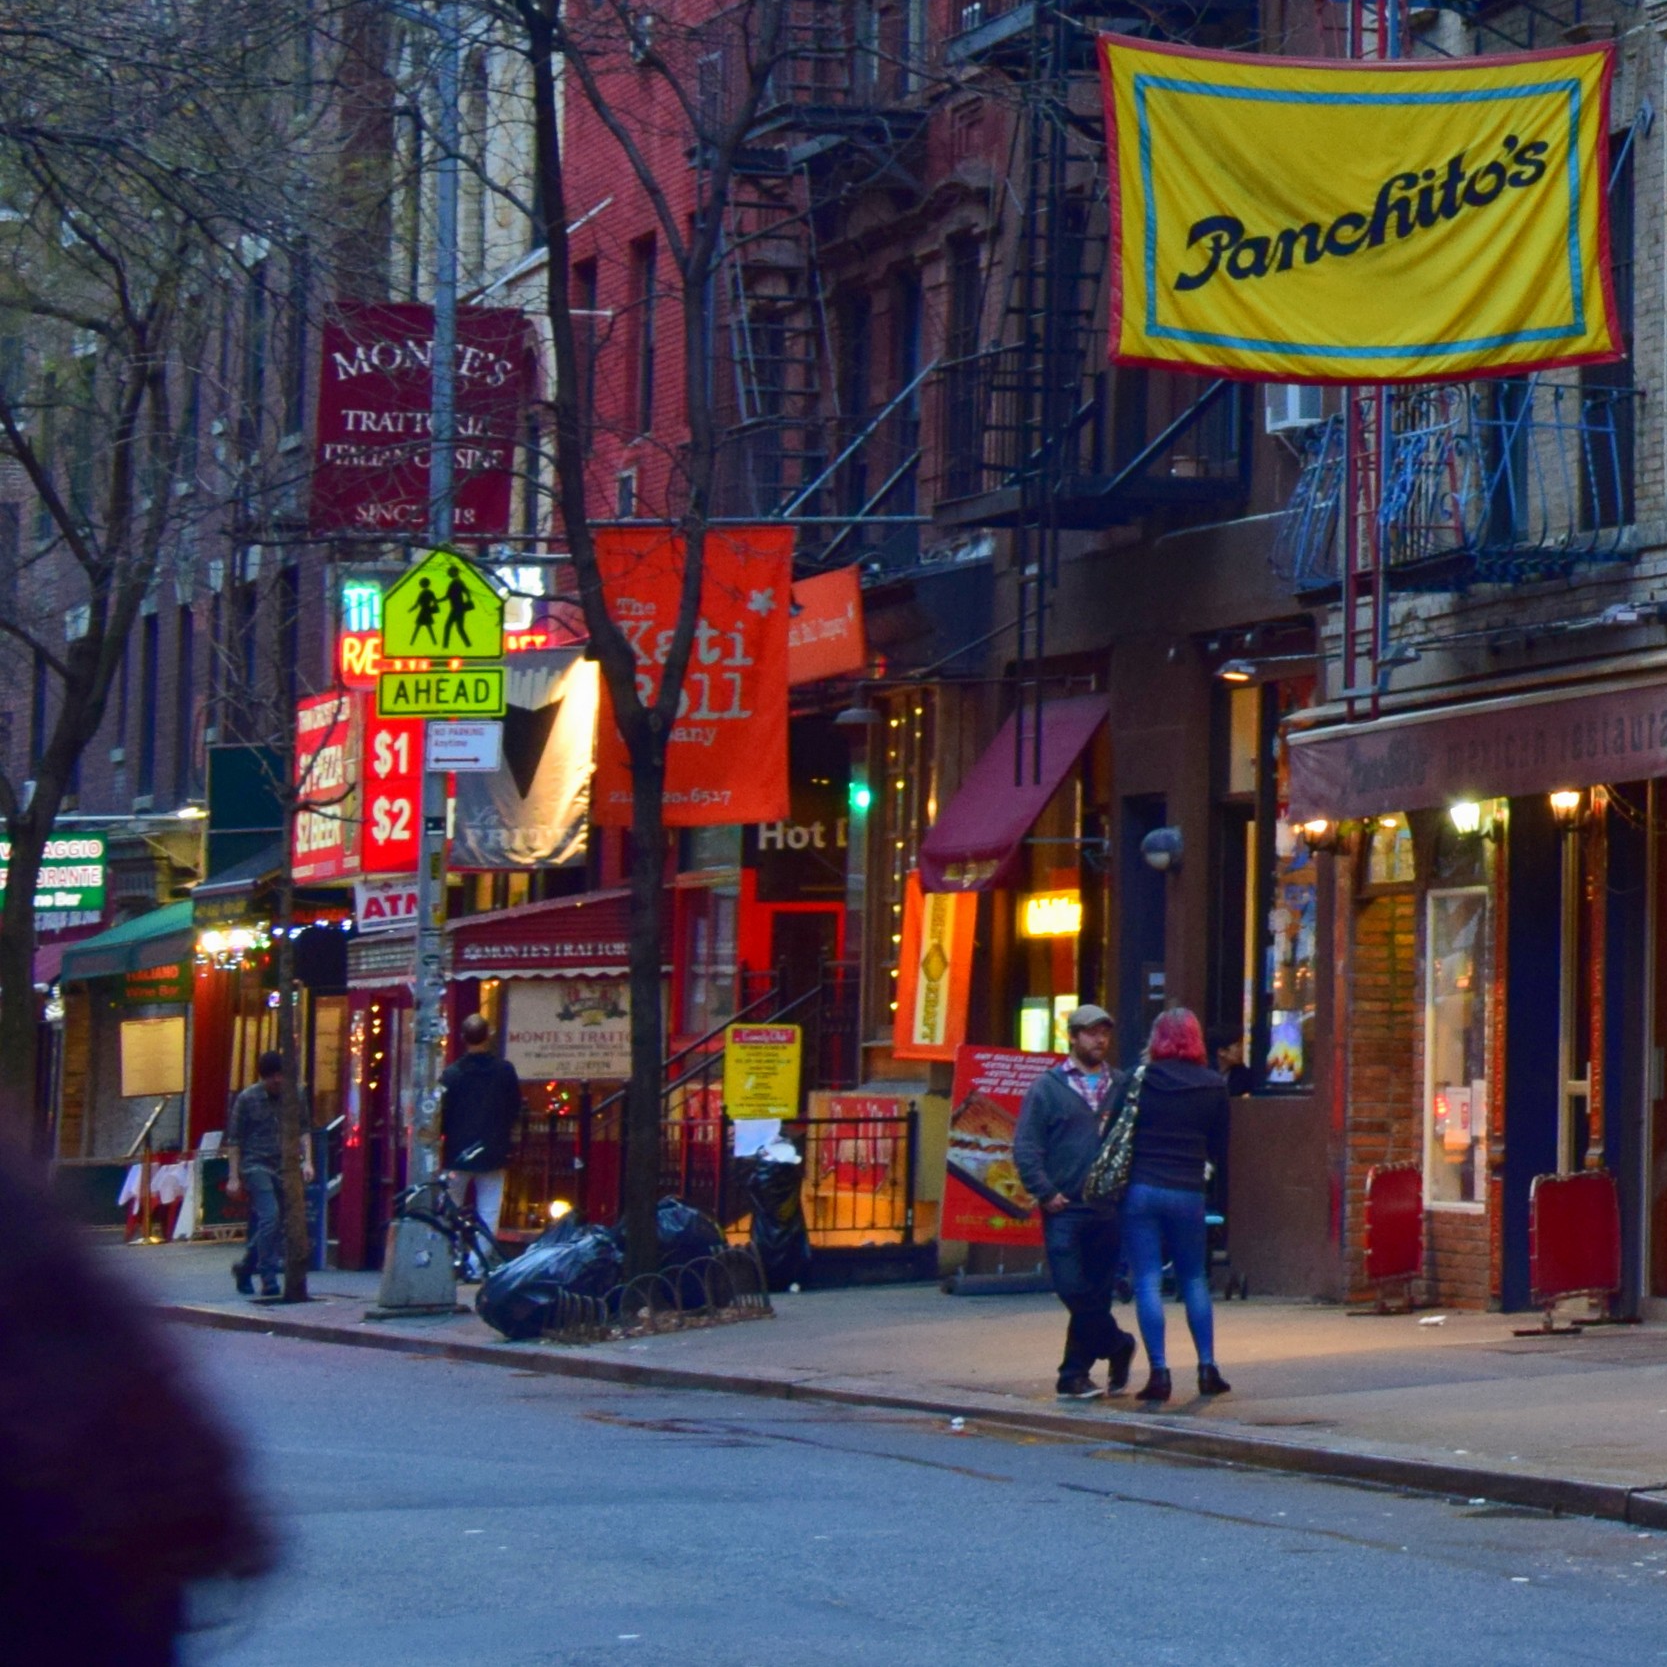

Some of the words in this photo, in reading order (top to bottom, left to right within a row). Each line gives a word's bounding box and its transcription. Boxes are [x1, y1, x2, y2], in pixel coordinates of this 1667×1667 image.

[1172, 133, 1550, 292] Panchito's
[616, 596, 657, 616] The
[618, 617, 753, 666] Kati
[392, 677, 490, 705] AHEAD
[373, 729, 409, 779] $1
[371, 795, 412, 846] $2
[757, 820, 827, 851] Hot
